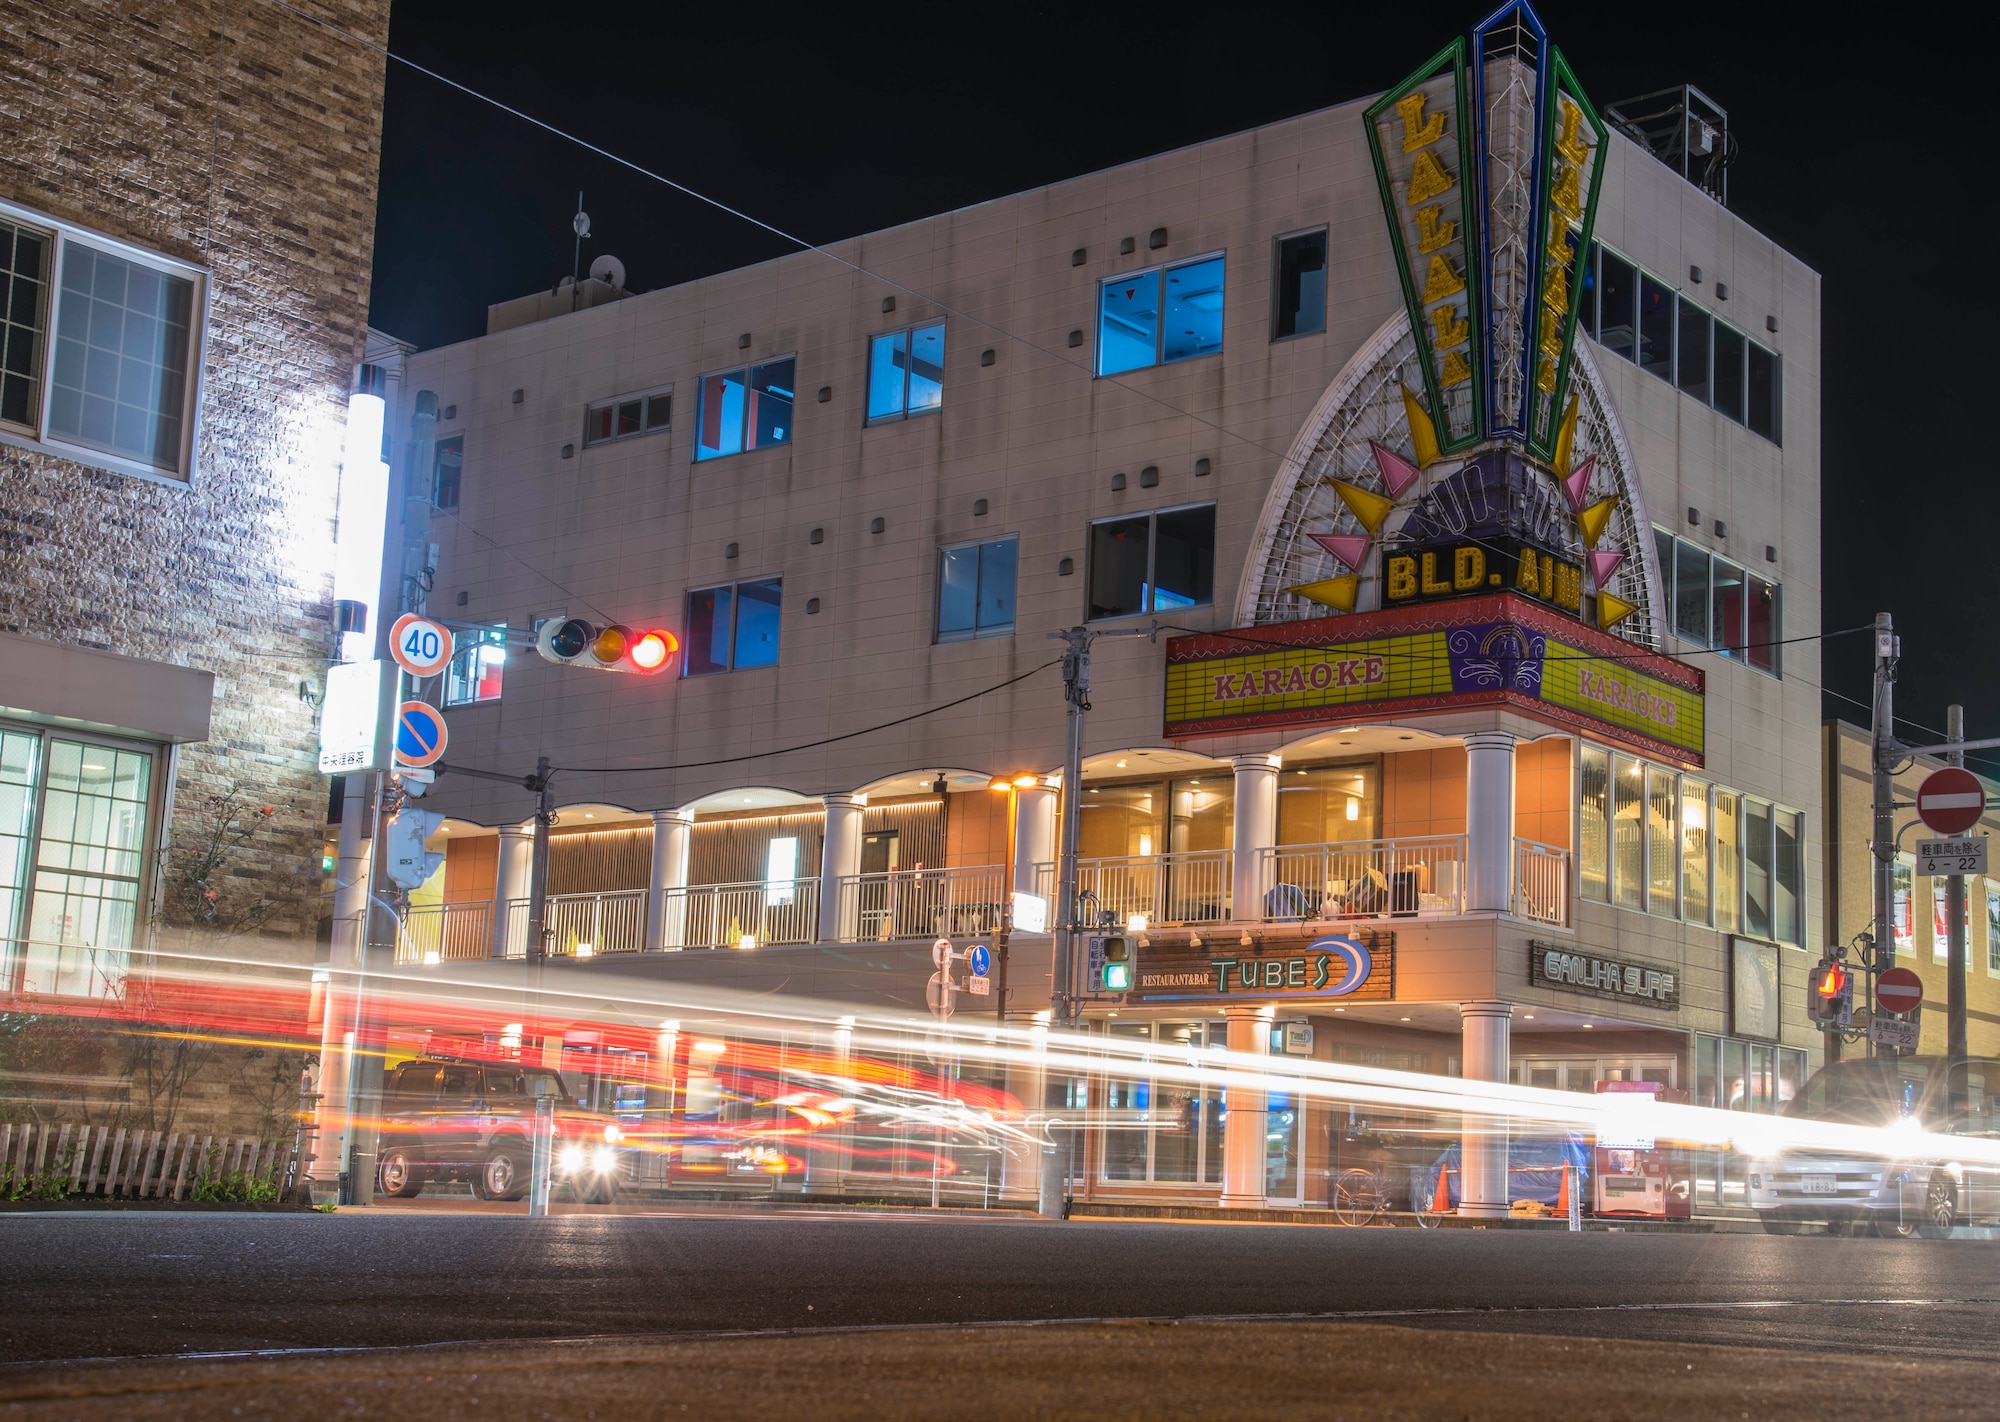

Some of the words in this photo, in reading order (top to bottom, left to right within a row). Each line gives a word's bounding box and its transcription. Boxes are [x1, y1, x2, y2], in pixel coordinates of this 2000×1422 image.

[1397, 93, 1471, 388] LALALA
[1538, 100, 1588, 393] LALALA
[1387, 547, 1502, 600] BLD.
[405, 629, 439, 659] 40
[1213, 655, 1386, 702] KARAOKE
[1579, 667, 1677, 729] KARAOKE
[1921, 842, 1982, 856] 軽車両を除く
[1142, 973, 1210, 987] RESTAURANT&BAR
[1210, 953, 1330, 993] TUBES
[1624, 966, 1674, 1000] SURF
